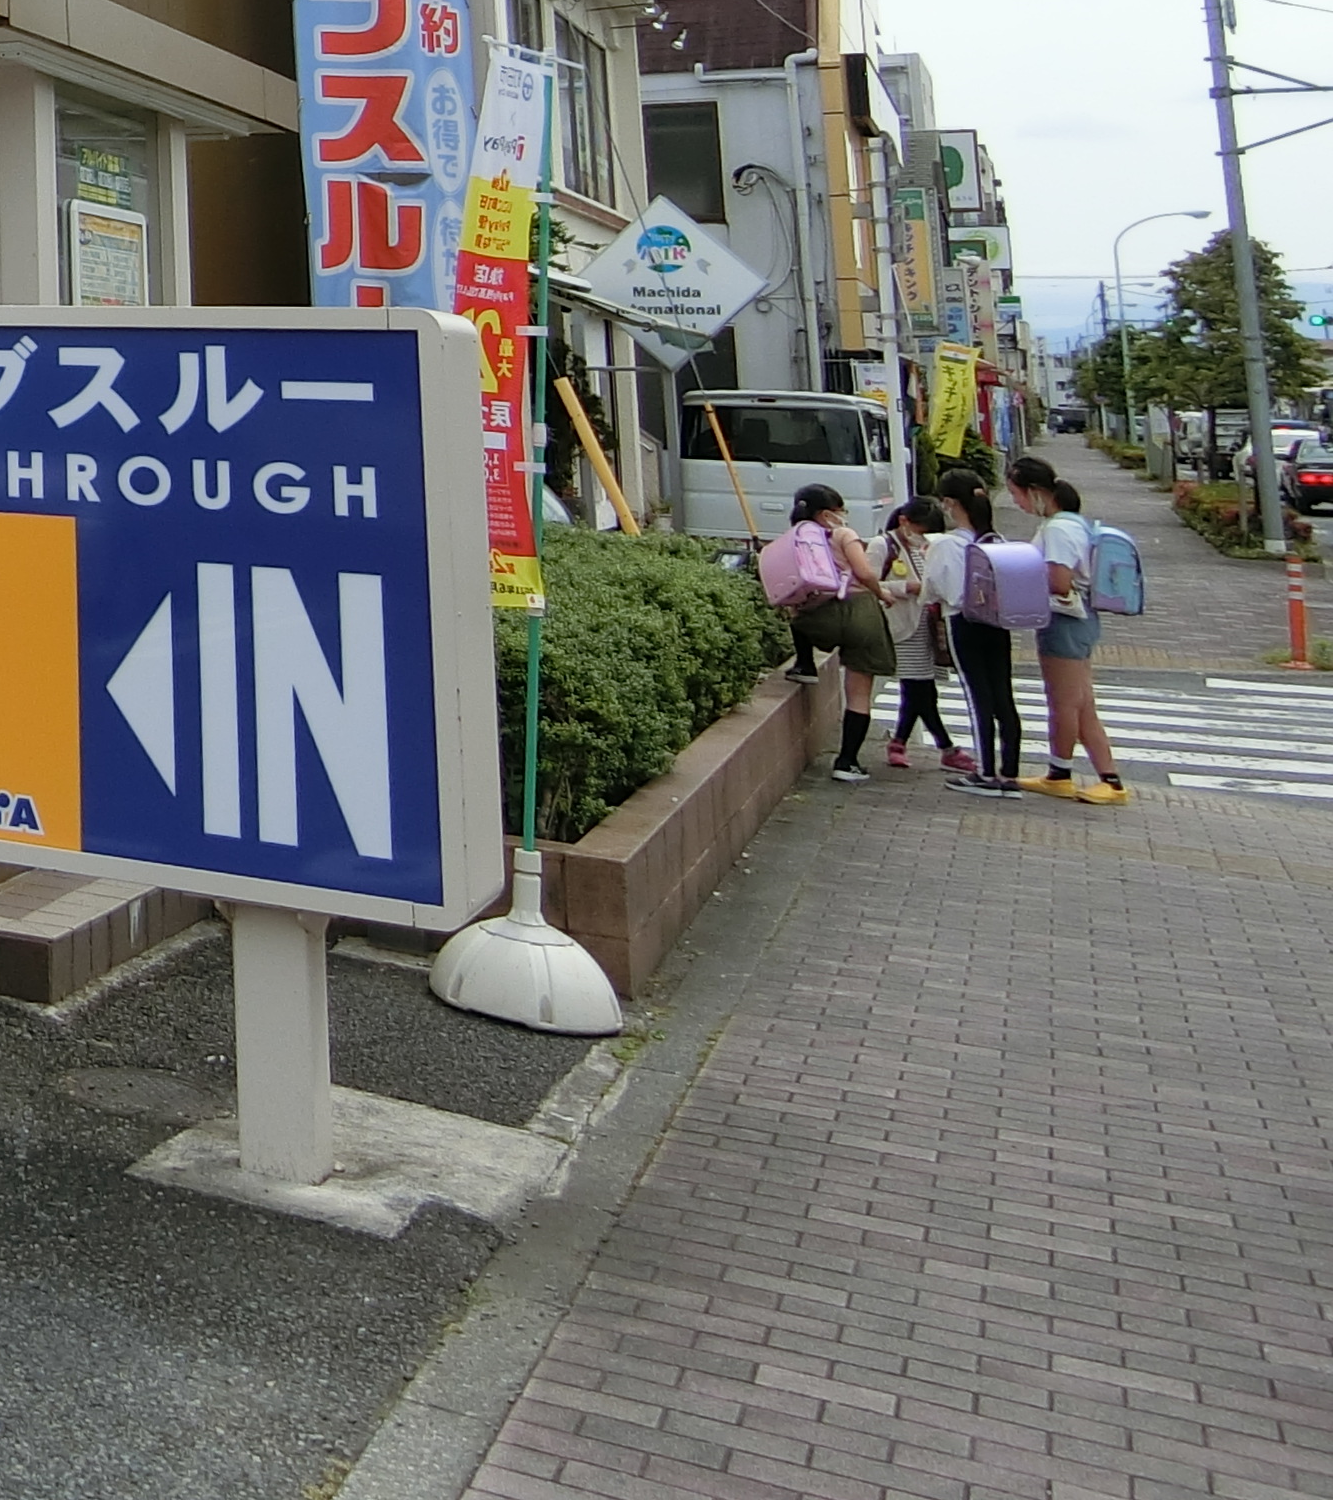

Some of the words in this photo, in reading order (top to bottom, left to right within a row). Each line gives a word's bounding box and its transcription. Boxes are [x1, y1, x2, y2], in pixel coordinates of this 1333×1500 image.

[430, 84, 461, 179] お得で
[632, 286, 702, 298] Machida
[195, 561, 394, 861] IN
